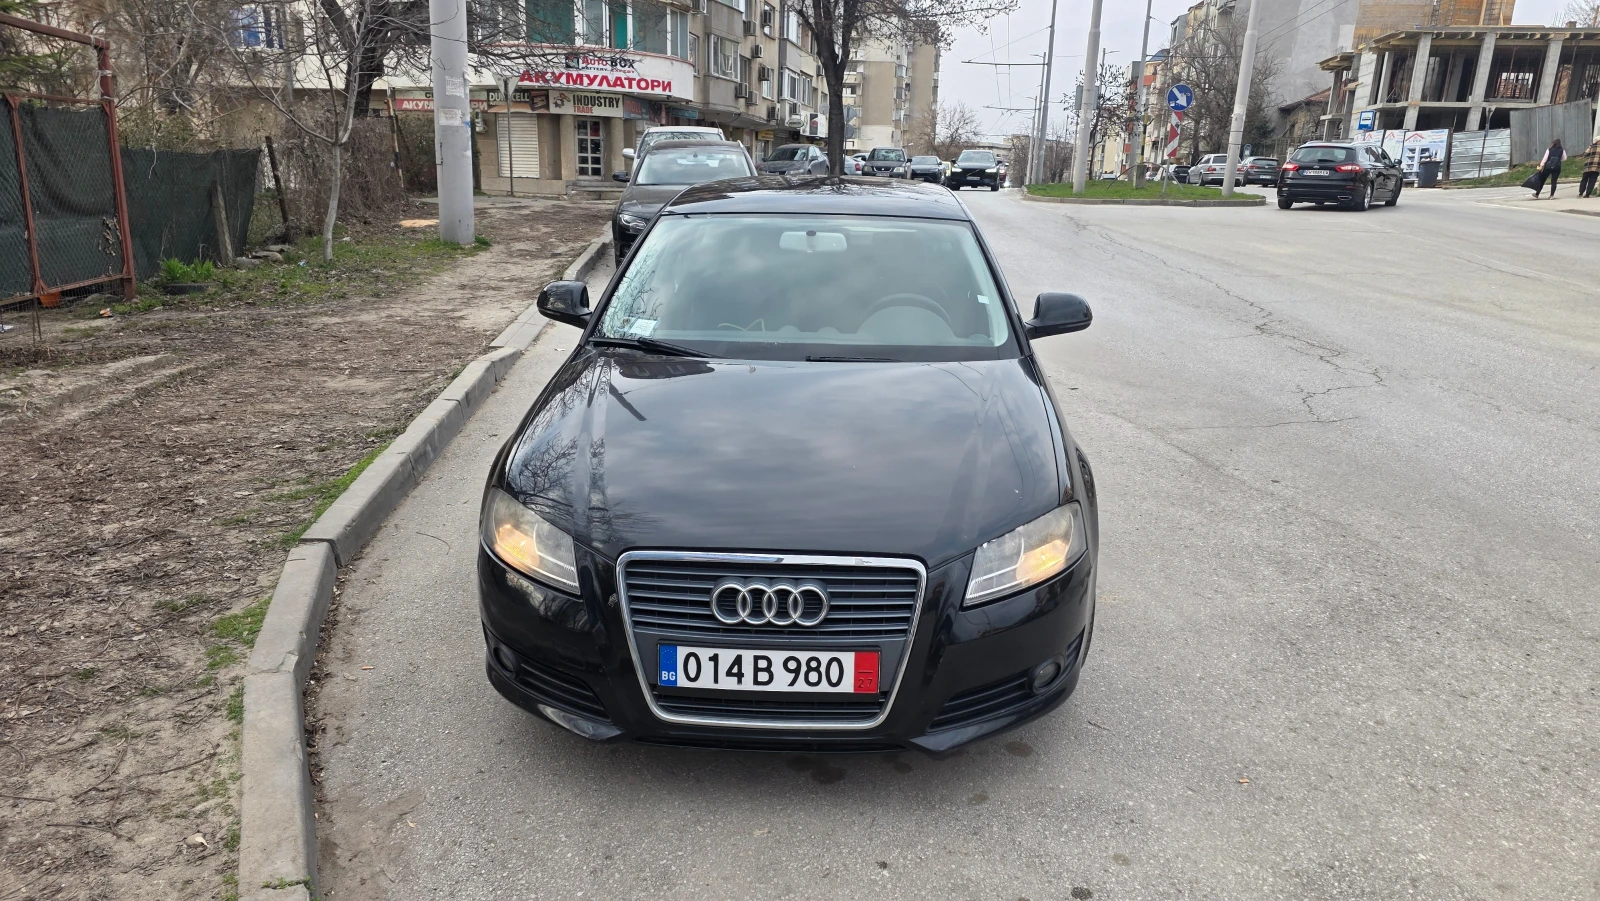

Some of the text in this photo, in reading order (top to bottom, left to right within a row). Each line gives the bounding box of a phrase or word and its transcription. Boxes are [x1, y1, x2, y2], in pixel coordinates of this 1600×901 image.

[610, 57, 636, 69] BOX
[519, 70, 672, 92] АКУМУЛАТОРИ
[573, 94, 620, 108] INDUSTRY
[573, 105, 594, 114] TRADE
[661, 670, 676, 681] BG
[857, 677, 874, 689] 27
